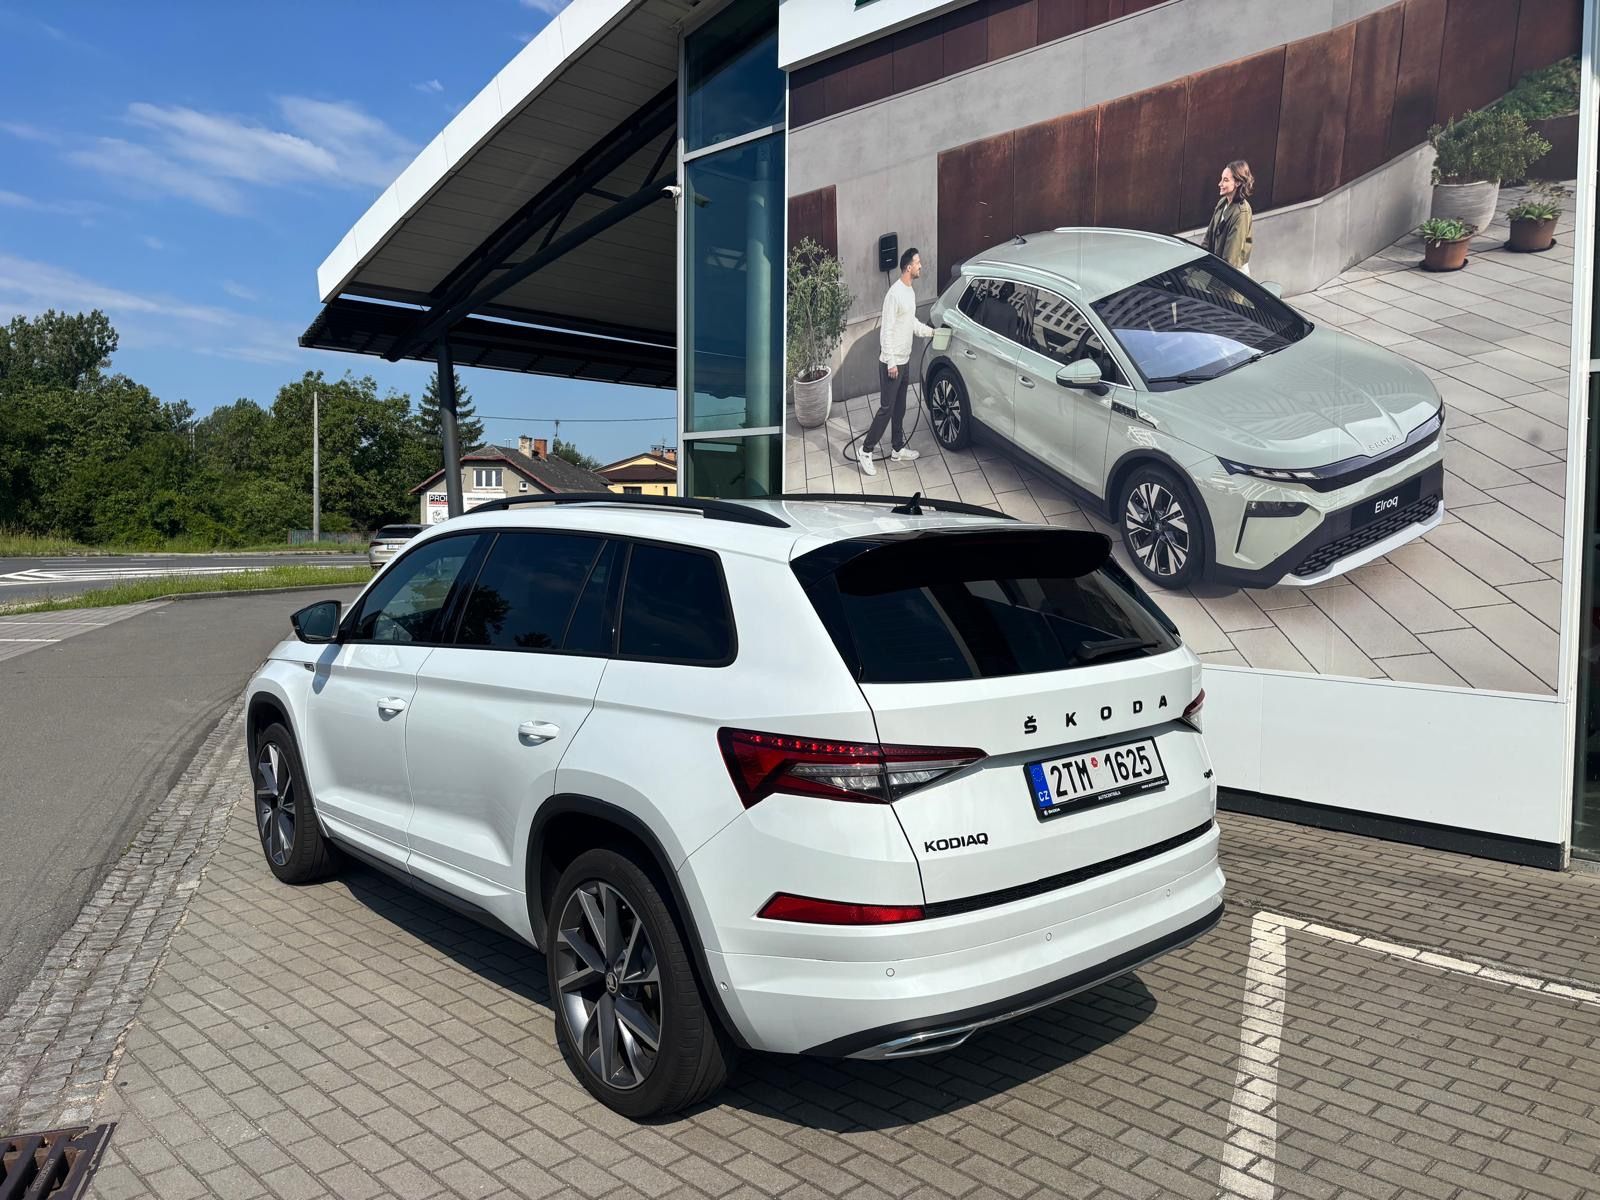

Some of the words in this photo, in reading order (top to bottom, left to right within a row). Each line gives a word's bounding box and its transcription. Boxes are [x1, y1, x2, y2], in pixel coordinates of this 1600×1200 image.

[1374, 495, 1399, 514] Elroq
[1024, 695, 1168, 734] ŠKODA
[1050, 758, 1093, 798] 2TM
[1104, 745, 1153, 784] 1625
[1038, 790, 1050, 802] CZ
[924, 832, 989, 853] KODIAQ
